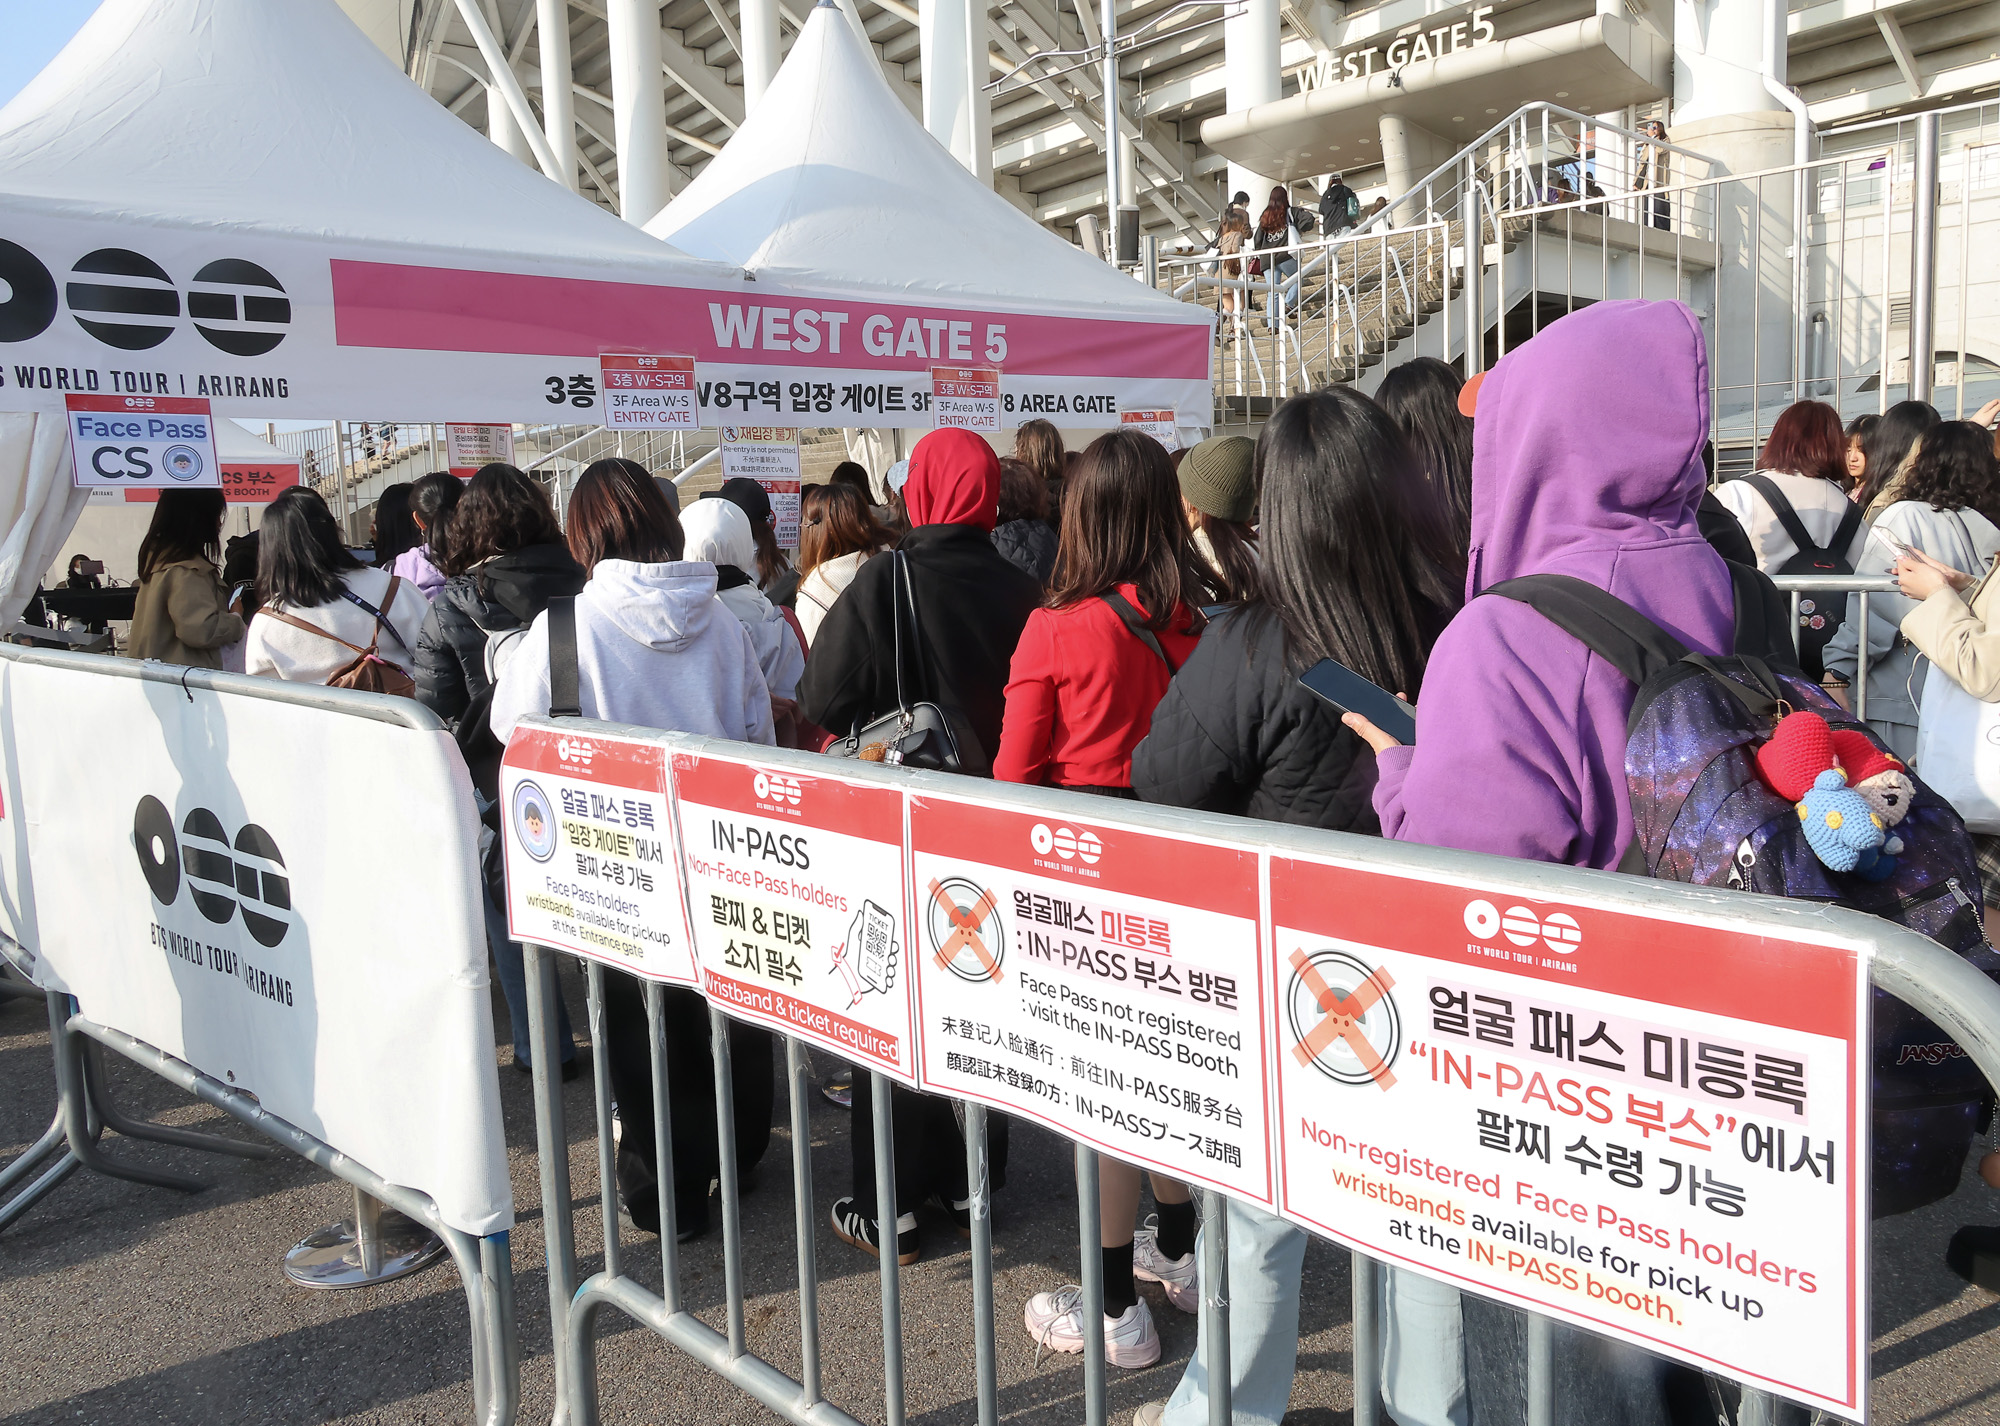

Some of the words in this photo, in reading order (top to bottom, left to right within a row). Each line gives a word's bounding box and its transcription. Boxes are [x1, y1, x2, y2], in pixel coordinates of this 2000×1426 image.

[1296, 46, 1378, 95] WEST
[1386, 21, 1469, 69] GATE
[1472, 6, 1498, 46] 5
[708, 302, 848, 354] WEST
[862, 314, 975, 361] GATE
[984, 324, 1008, 362] 5
[14, 365, 99, 391] WORLD
[110, 370, 169, 394] TOUR
[197, 375, 289, 398] ARIRANG
[545, 374, 596, 408] 3층
[791, 382, 835, 414] 입장
[840, 383, 907, 415] 게이트
[911, 392, 931, 412] 3F
[1019, 394, 1068, 413] AREA
[1072, 394, 1116, 413] GATE
[612, 373, 633, 387] 3층
[635, 374, 686, 388] W-S구역
[612, 394, 628, 407] 3F
[631, 395, 660, 407] Area
[660, 395, 689, 407] W-S
[940, 383, 954, 395] 3층
[956, 384, 992, 396] W-S구역
[77, 417, 141, 438] Face
[148, 418, 207, 439] Pass
[613, 411, 656, 423] ENTRY
[658, 411, 691, 423] GATE
[939, 402, 950, 412] 3F
[952, 402, 973, 413] Area
[975, 403, 994, 413] W-S
[940, 415, 969, 426] ENTRY
[971, 416, 994, 426] GATE
[723, 446, 750, 454] Re-entry
[740, 427, 773, 440] 재입장
[775, 427, 795, 441] 불가
[92, 446, 153, 479] CS
[247, 471, 276, 485] 부스
[234, 488, 270, 496] BOOTH
[561, 787, 589, 818] 얼굴
[591, 794, 621, 823] 패스
[623, 799, 655, 831] 등록
[562, 820, 591, 848] “입장
[711, 819, 811, 870] IN-PASS
[575, 852, 599, 879] 팔찌
[602, 860, 625, 886] 수령
[628, 866, 654, 893] 가능
[688, 852, 752, 887] Non-Face
[754, 870, 789, 896] Pass
[791, 878, 848, 912] holders
[1043, 860, 1060, 870] WORLD
[526, 894, 575, 918] wristbands
[576, 907, 615, 930] available
[616, 917, 630, 934] for
[545, 876, 570, 896] Face
[571, 883, 596, 905] Pass
[597, 890, 640, 918] holders
[552, 918, 561, 931] at
[561, 921, 577, 937] the
[579, 925, 621, 951] Entrance
[622, 938, 644, 959] gate
[710, 894, 746, 932] 팔찌
[752, 907, 768, 936] &
[773, 912, 811, 949] 티켓
[869, 912, 888, 931] TICKET
[1012, 888, 1095, 936] 얼굴패스
[1100, 910, 1172, 954] 미등록
[151, 922, 168, 950] BTS
[168, 930, 203, 966] WORLD
[206, 945, 240, 978] TOUR
[244, 962, 293, 1007] ARIRANG
[724, 938, 761, 974] 소지
[765, 948, 804, 986] 필수
[1467, 943, 1481, 954] BTS
[1483, 947, 1510, 960] WORLD
[1512, 952, 1533, 965] TOUR
[1541, 958, 1578, 973] ARIRANG
[1134, 958, 1182, 997] 부스
[1189, 969, 1238, 1012] 방문
[704, 972, 772, 1012] Wristband
[775, 994, 787, 1017] &
[788, 1000, 831, 1033] ticket
[833, 1020, 899, 1063] required
[1019, 972, 1057, 998] Face
[1060, 984, 1098, 1011] Pass
[1102, 995, 1133, 1021] not
[1138, 1008, 1241, 1051] registered
[1029, 1003, 1060, 1026] visit
[1063, 1013, 1091, 1036] the
[1095, 1022, 1173, 1060] IN-PASS
[1177, 1042, 1239, 1079] Booth
[1428, 985, 1516, 1049] 얼굴
[1528, 1007, 1626, 1073] 패스
[1642, 1030, 1808, 1117] 미등록
[1896, 1042, 1968, 1066] JANSPO
[1409, 1039, 1614, 1126] “IN-PASS
[1625, 1092, 1835, 1186] 부스”에서
[1476, 1108, 1552, 1164] 팔찌
[1565, 1133, 1645, 1190] 수령
[1658, 1156, 1747, 1219] 가능
[1301, 1116, 1501, 1201] Non-registered
[1515, 1180, 1589, 1225] Face
[1596, 1202, 1670, 1252] Pass
[1678, 1226, 1818, 1295] holders
[1331, 1168, 1466, 1227] wristbands
[1471, 1209, 1595, 1265] available
[1599, 1245, 1641, 1279] for
[1647, 1262, 1713, 1306] pick
[1720, 1291, 1765, 1322] up
[1388, 1216, 1412, 1237] at
[1418, 1222, 1462, 1256] the
[1466, 1237, 1580, 1293] IN-PASS
[1585, 1271, 1683, 1327] booth.
